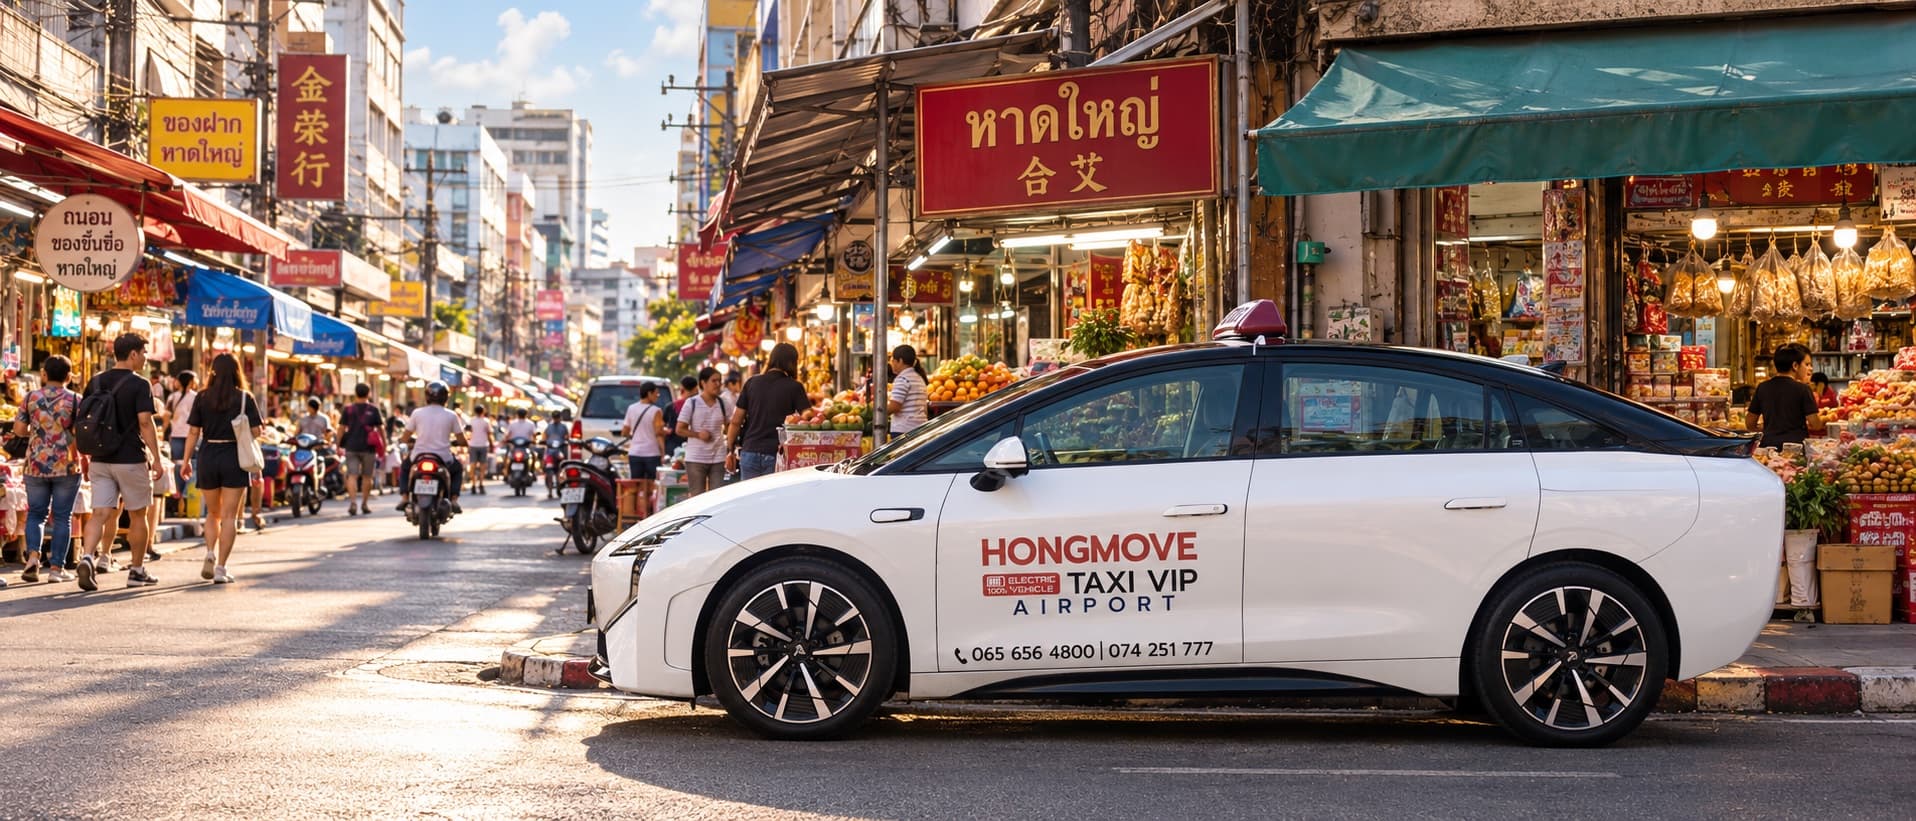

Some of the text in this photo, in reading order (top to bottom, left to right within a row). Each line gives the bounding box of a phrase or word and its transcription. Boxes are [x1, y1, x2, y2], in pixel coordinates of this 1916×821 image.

[163, 111, 242, 134] ของฝาก
[966, 76, 1160, 149] หาดใหญ่
[290, 65, 333, 189] 金荣行
[981, 532, 1198, 566] HONGMOVE
[1007, 575, 1056, 585] ELECTRIC
[1009, 585, 1054, 594] VEHICLE
[1067, 569, 1198, 594] TAXI VIP
[1013, 595, 1175, 615] AIRPORT
[972, 641, 1214, 661] 065 656 4800 074 251 777
